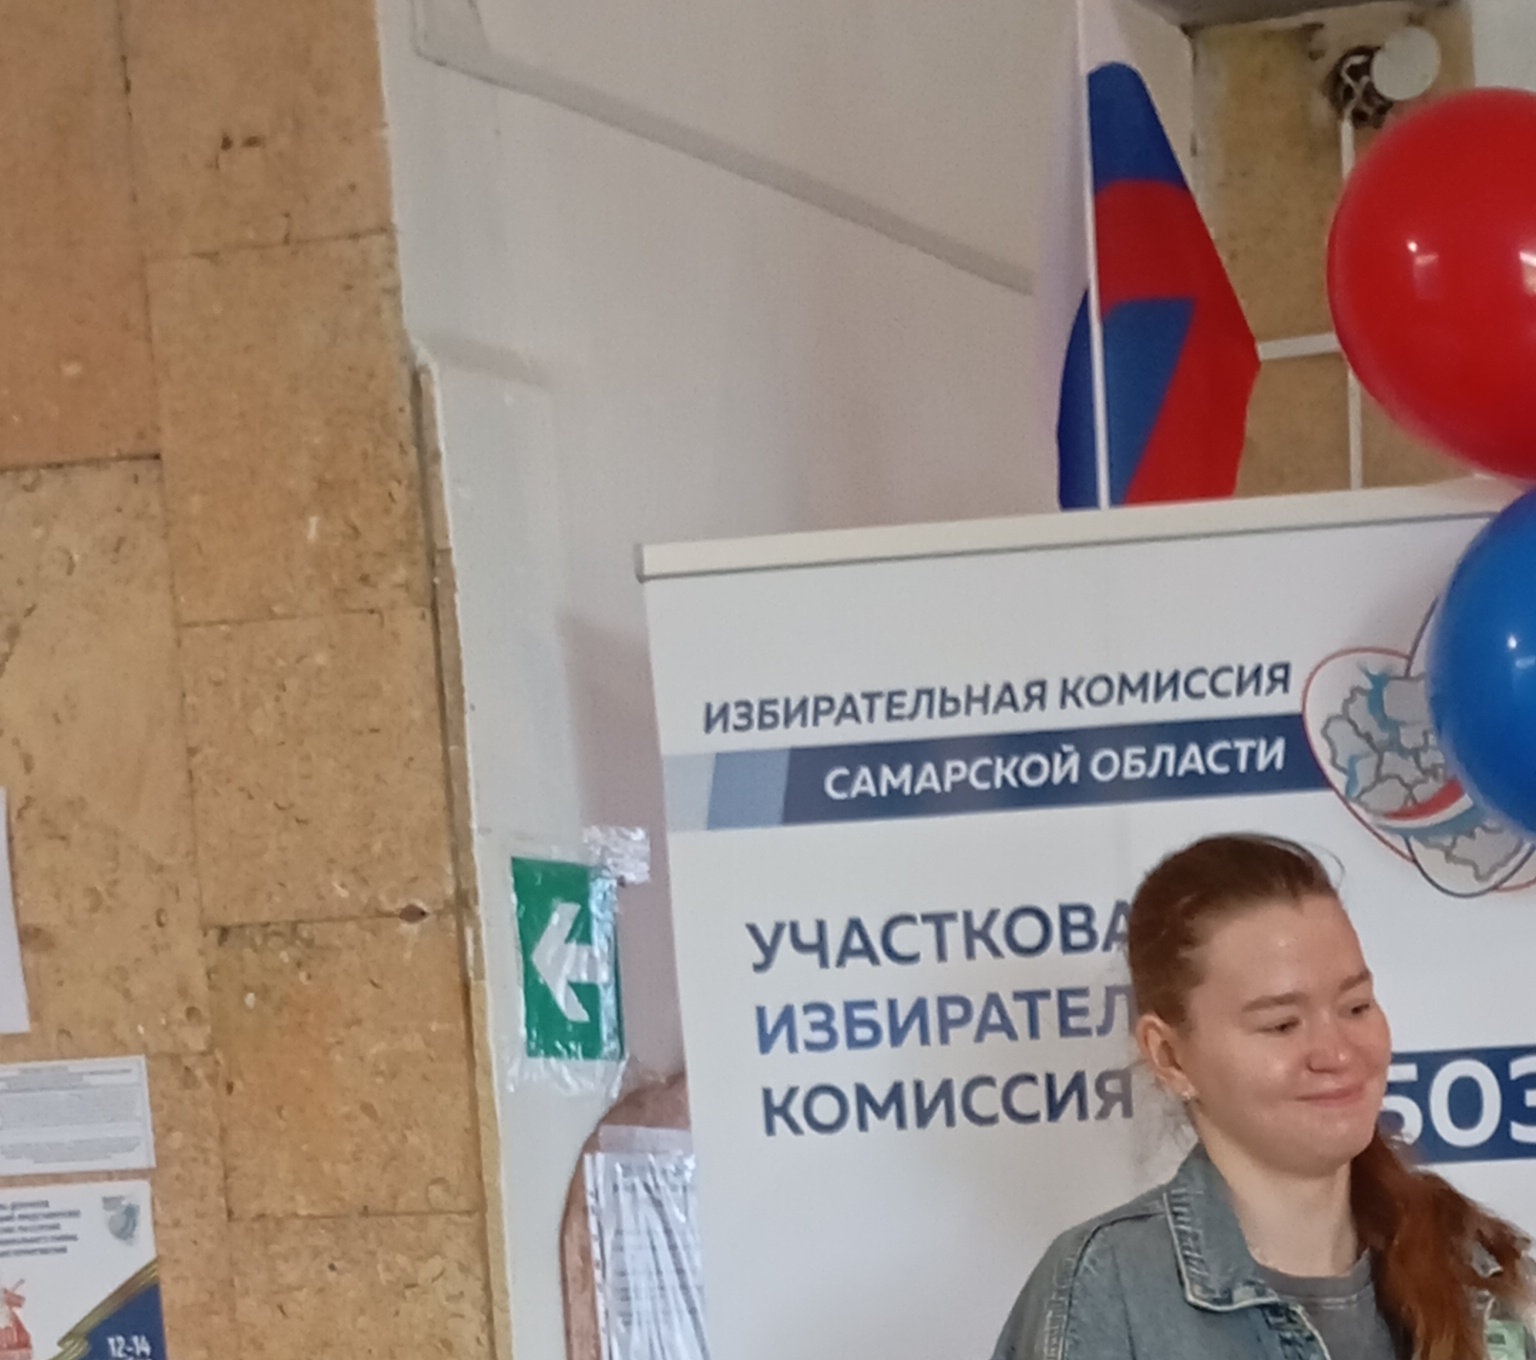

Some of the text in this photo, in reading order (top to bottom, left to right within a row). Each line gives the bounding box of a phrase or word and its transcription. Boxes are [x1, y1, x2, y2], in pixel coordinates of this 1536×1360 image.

[702, 662, 1292, 734] ИЗБИРАТЕЛЬНАЯ КОМИССИЯ
[823, 737, 1286, 800] САМАРСКОЙ ОБЛАСТИ
[745, 899, 1131, 974] УЧАСТКОВА
[755, 984, 1137, 1055] ИЗБИРАТЕЛ
[761, 1069, 1133, 1136] КОМИССИЯ
[107, 1335, 151, 1358] 12-14
